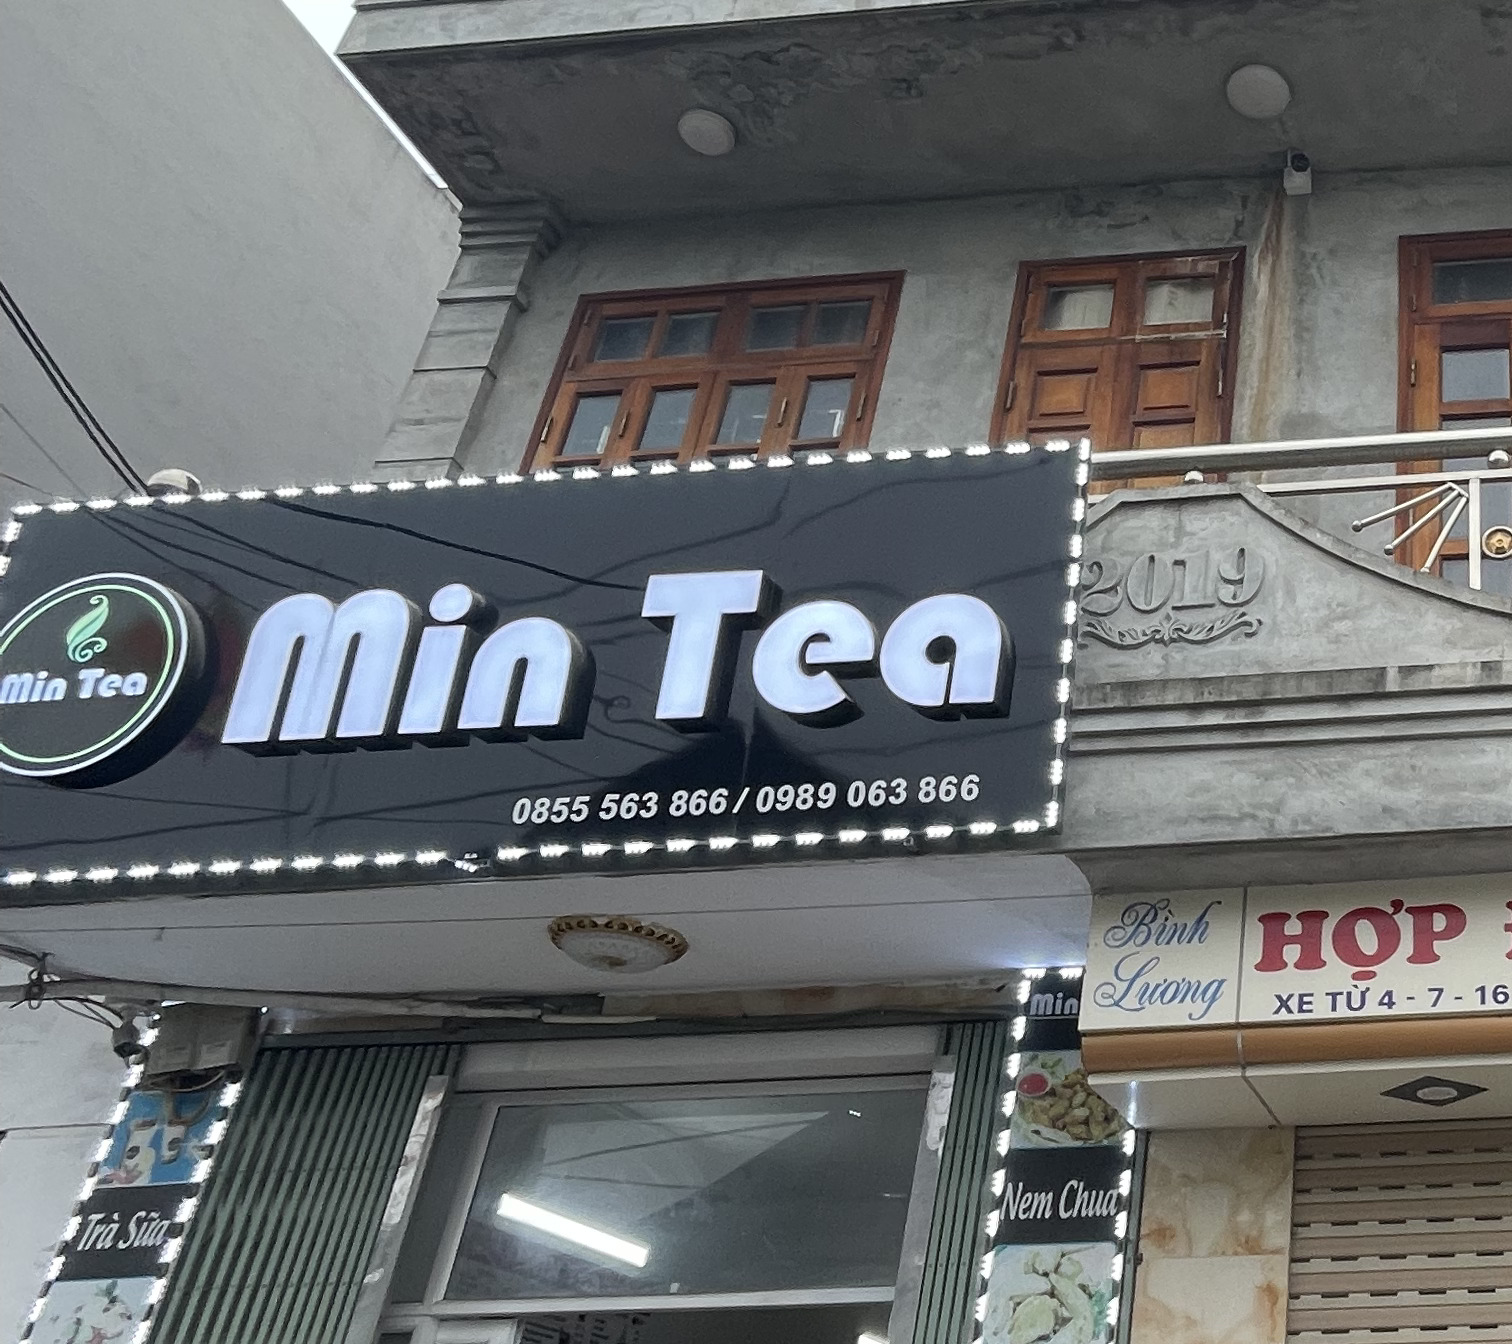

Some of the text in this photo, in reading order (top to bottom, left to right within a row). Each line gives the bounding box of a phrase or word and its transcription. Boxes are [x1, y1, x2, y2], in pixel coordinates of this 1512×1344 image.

[1081, 547, 1265, 617] 2019
[221, 568, 1011, 743] Min Tea
[0, 667, 148, 704] Min Tea
[512, 774, 980, 825] 0855 563 866 / 0989 063 866
[1103, 897, 1222, 950] Bình
[1253, 898, 1467, 982] HỢP
[1029, 991, 1079, 1016] Min
[1093, 952, 1227, 1020] Lương
[1272, 991, 1314, 1016] XE
[1325, 982, 1371, 1011] TỪ
[1377, 989, 1397, 1010] 4
[1427, 987, 1443, 1008] 7
[1474, 983, 1511, 1006] 16
[1000, 1178, 1119, 1221] Nem Chua
[77, 1210, 172, 1251] Trà Sữa
